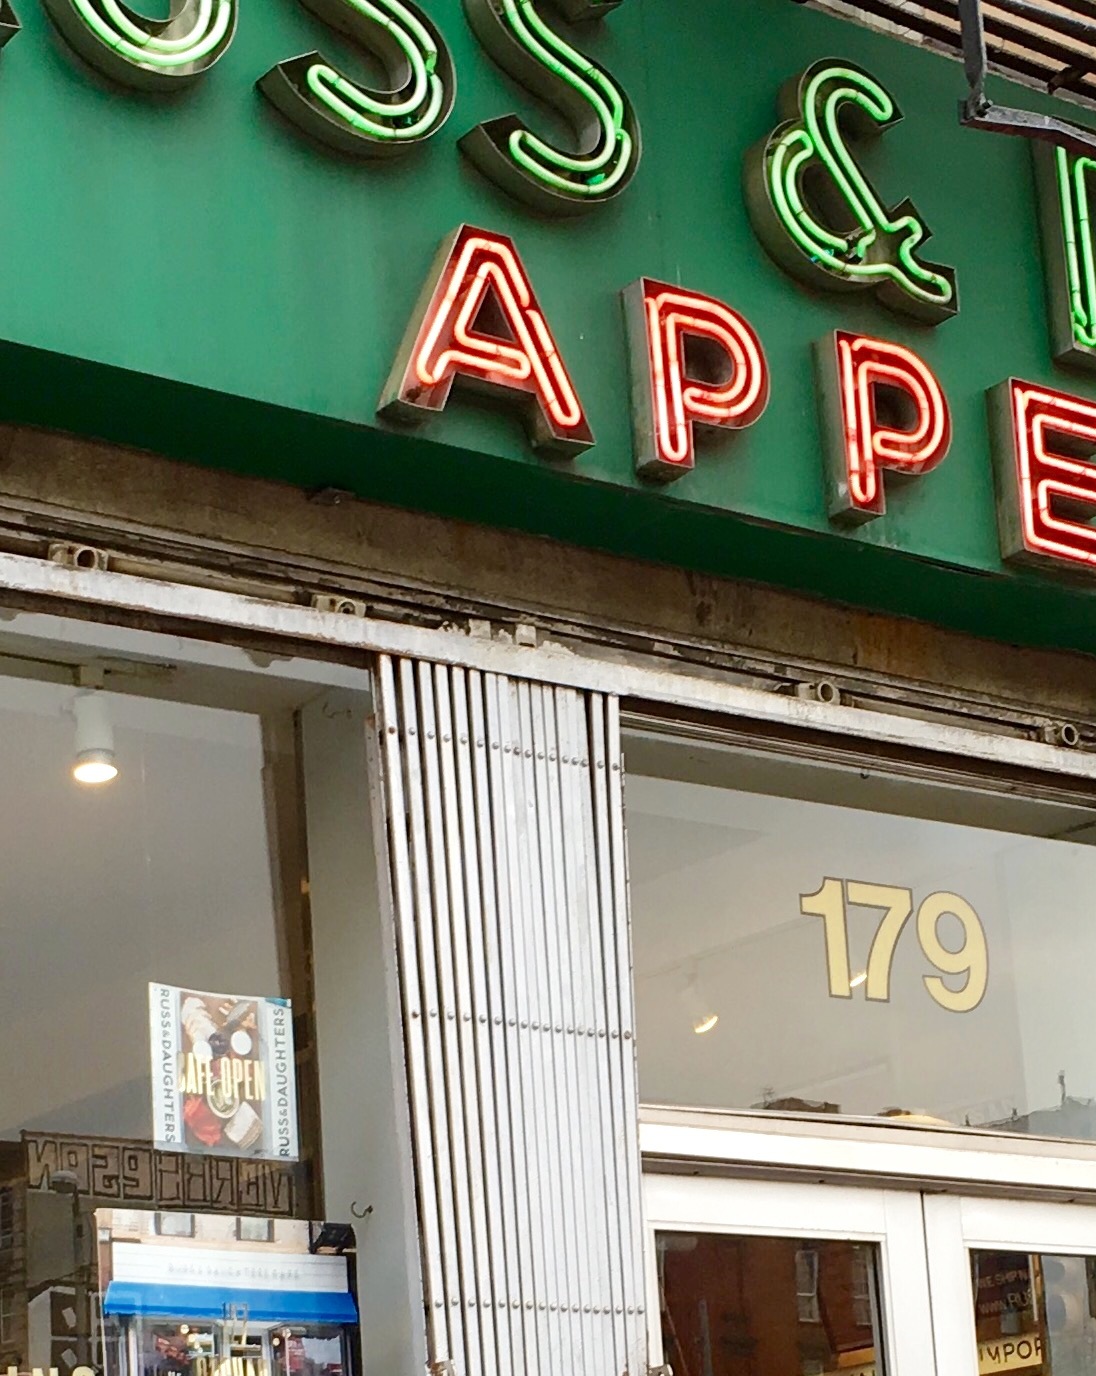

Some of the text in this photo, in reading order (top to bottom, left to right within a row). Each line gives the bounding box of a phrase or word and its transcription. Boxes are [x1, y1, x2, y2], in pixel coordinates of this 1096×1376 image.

[745, 57, 958, 326] &
[799, 876, 989, 1013] 179
[220, 1057, 266, 1101] OPEN
